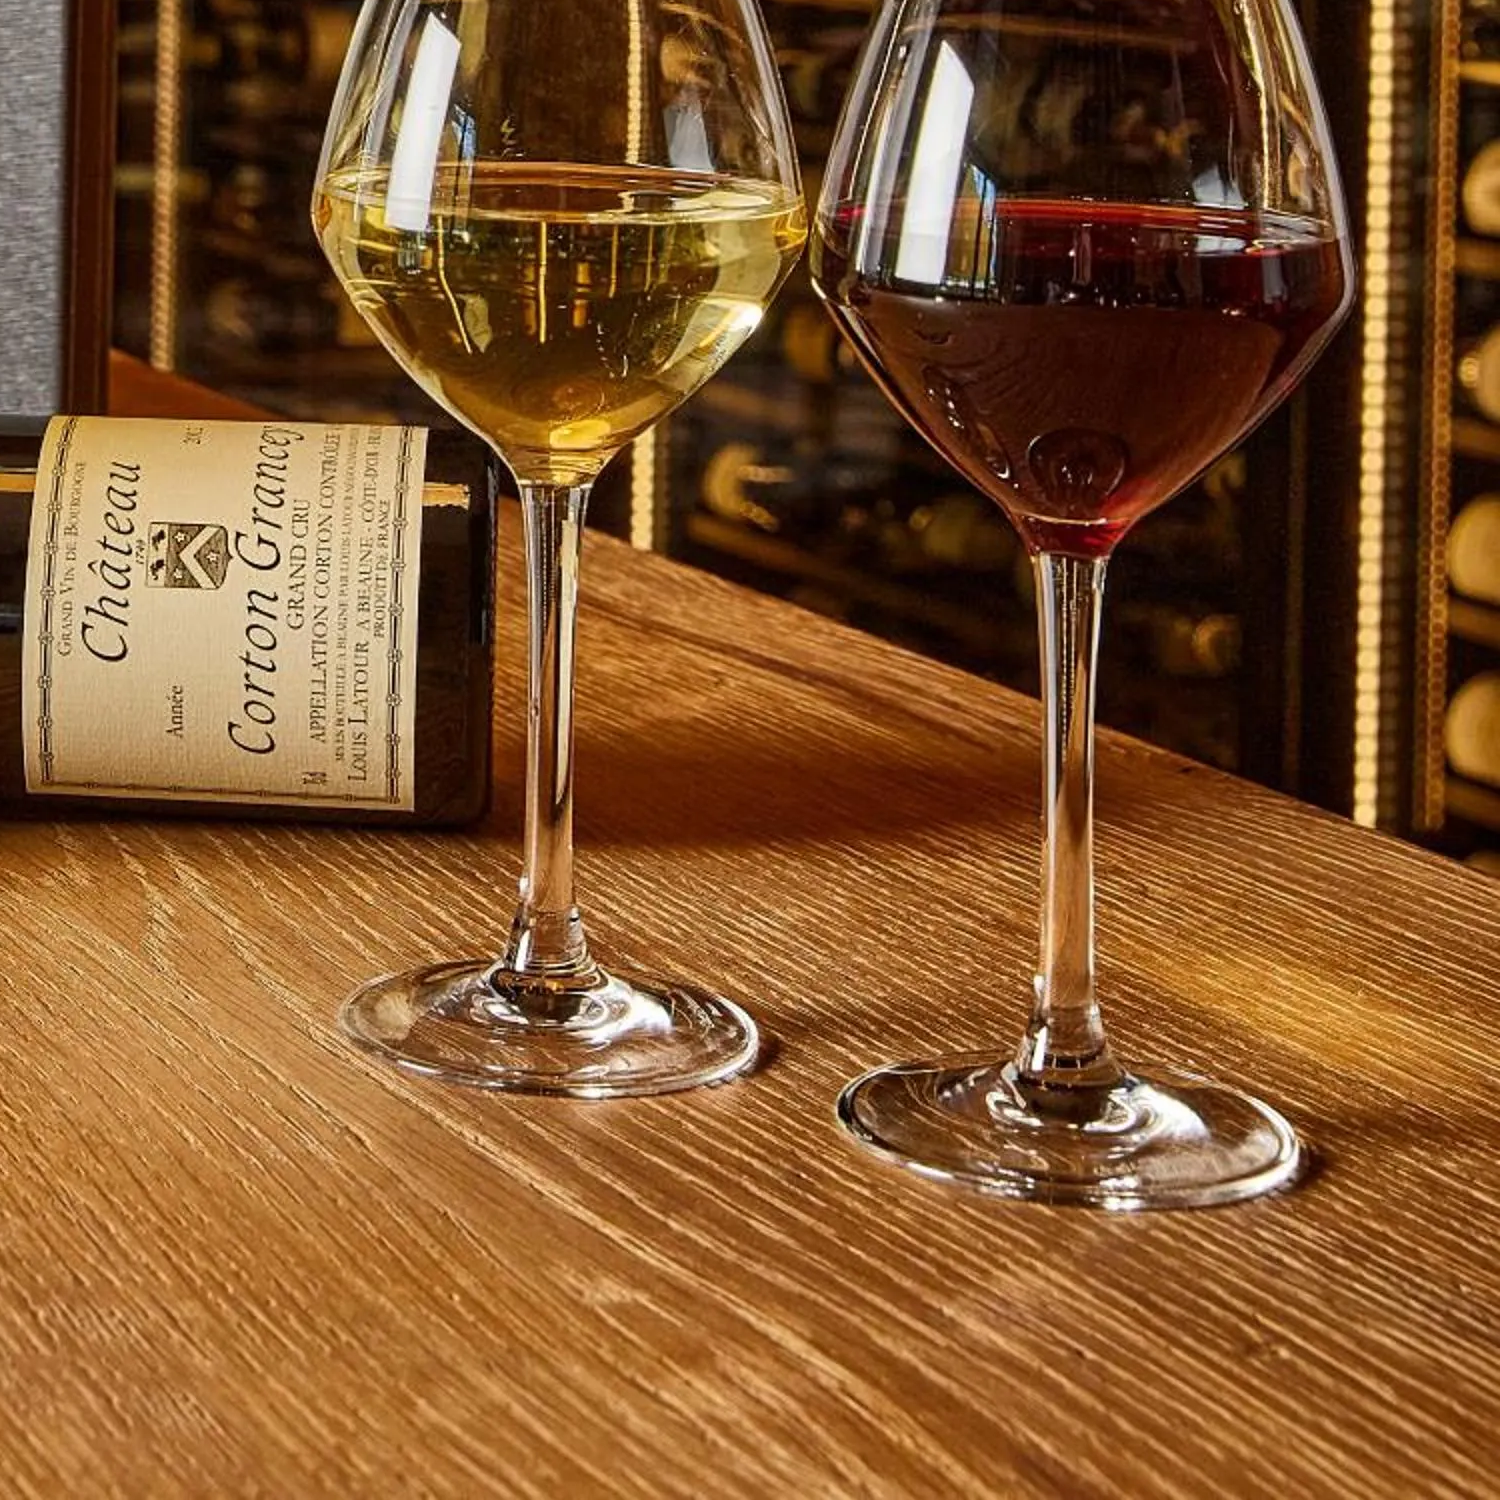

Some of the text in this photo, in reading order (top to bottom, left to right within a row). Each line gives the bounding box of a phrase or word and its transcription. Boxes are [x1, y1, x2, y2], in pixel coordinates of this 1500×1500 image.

[57, 461, 87, 657] GRAND VIN DE BOURGOGNE
[80, 460, 141, 663] Château
[285, 499, 311, 631] GRAND CRU
[313, 514, 333, 599] CORTON
[376, 499, 391, 549] FRANCE
[227, 424, 305, 755] Corton Grancey
[356, 536, 374, 613] BEAUNE
[373, 572, 388, 638] PRODUIT
[165, 684, 184, 739] Année
[309, 604, 329, 743] APPELLATION
[347, 640, 370, 726] LATOUR
[347, 731, 368, 781] LOUIS
